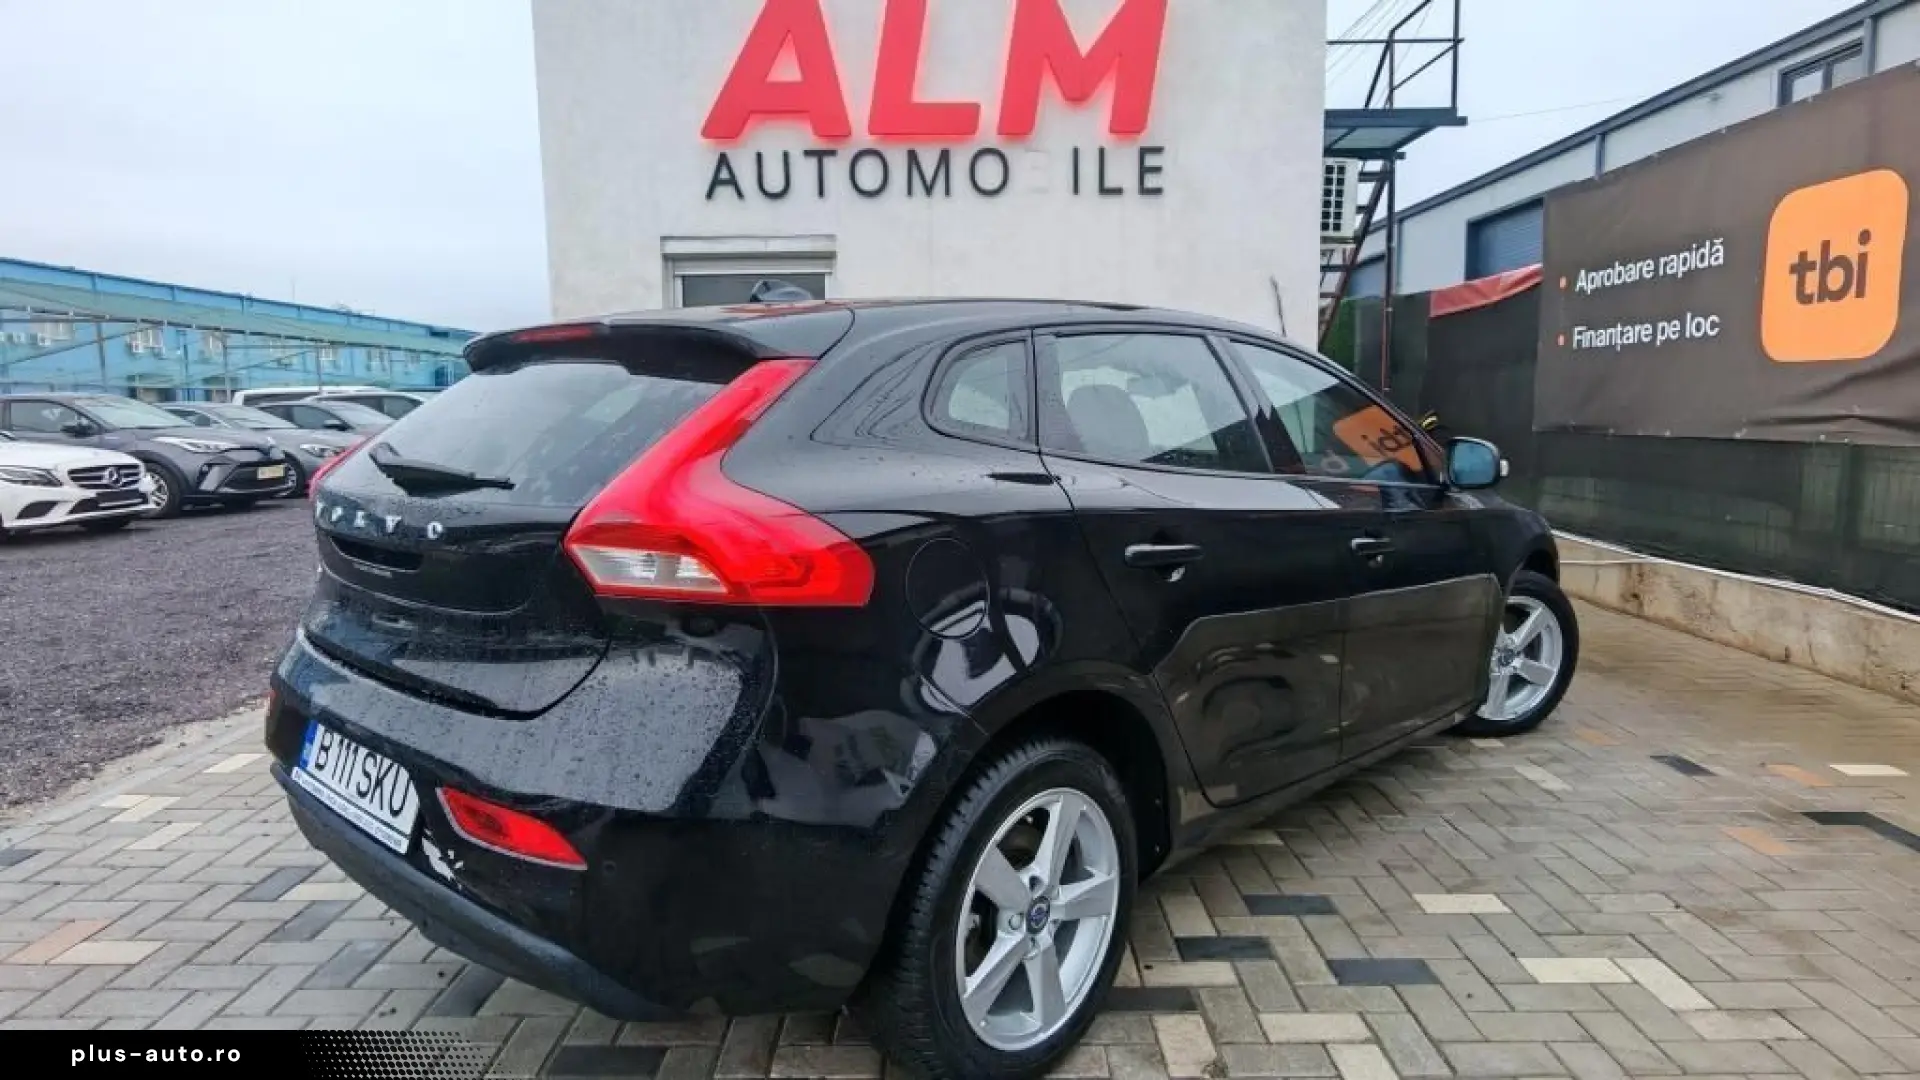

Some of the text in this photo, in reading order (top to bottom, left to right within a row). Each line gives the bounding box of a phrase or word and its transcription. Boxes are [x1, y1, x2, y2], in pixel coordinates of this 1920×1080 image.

[701, 0, 1168, 140] ALM
[705, 146, 1165, 200] AUTOMOILE
[1575, 236, 1725, 294] Aprobare rapidă
[1789, 229, 1872, 305] tbi
[1572, 312, 1721, 352] Finanțare pe loc
